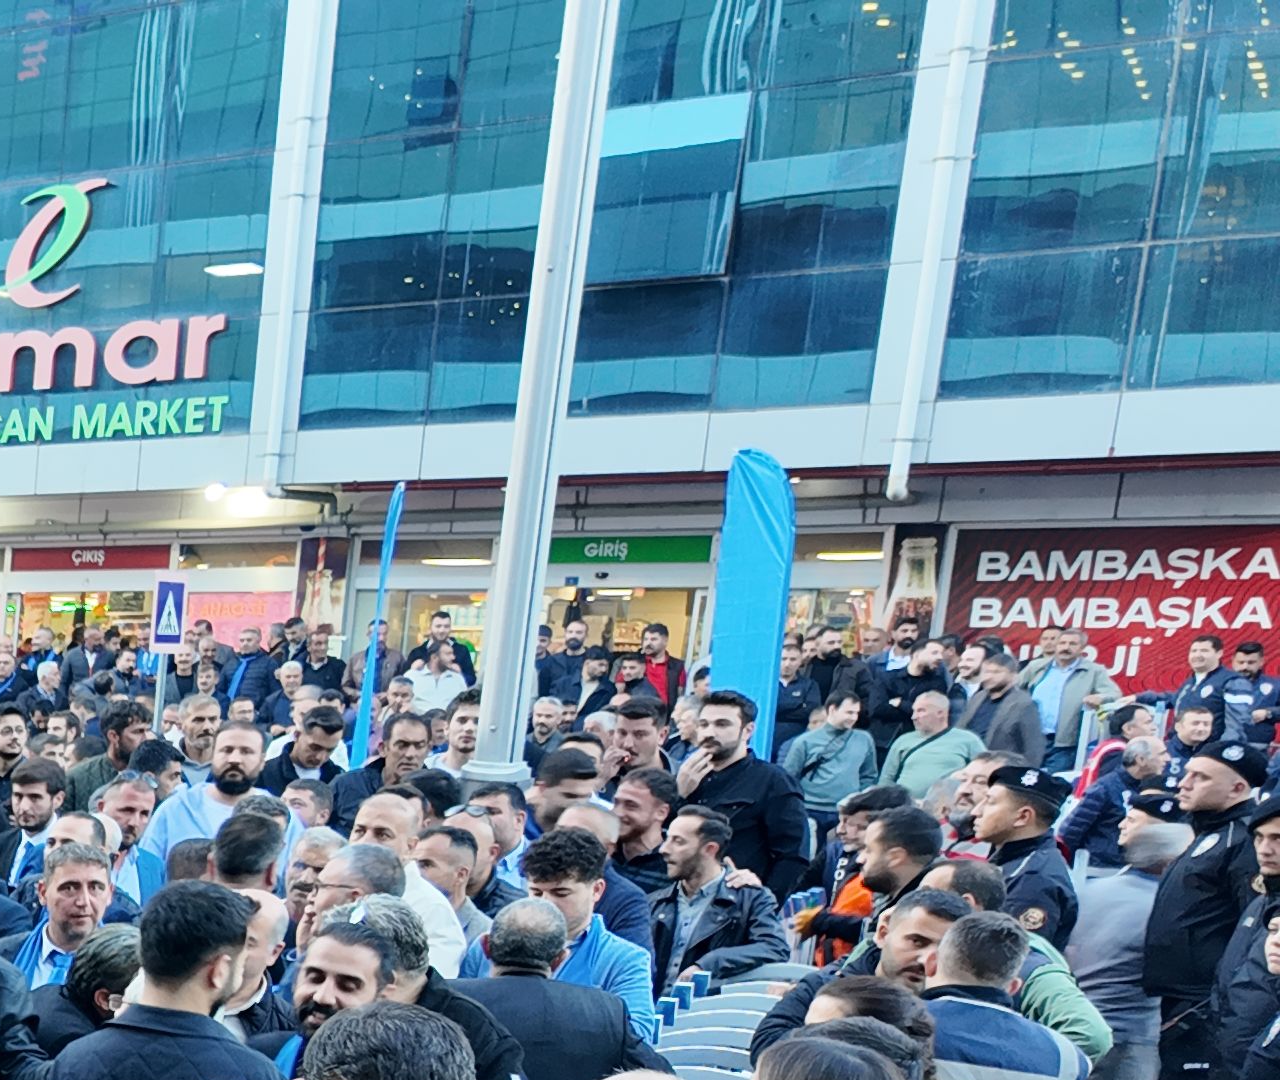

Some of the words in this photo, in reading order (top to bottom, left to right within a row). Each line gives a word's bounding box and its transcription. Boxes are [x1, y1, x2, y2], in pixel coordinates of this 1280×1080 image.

[71, 395, 230, 441] MARKET
[71, 549, 105, 567] ÇIKIŞ
[584, 539, 628, 561] GİRİŞ
[976, 547, 1280, 589] BAMBAŞKA
[969, 597, 1273, 638] BAMBAŞKA
